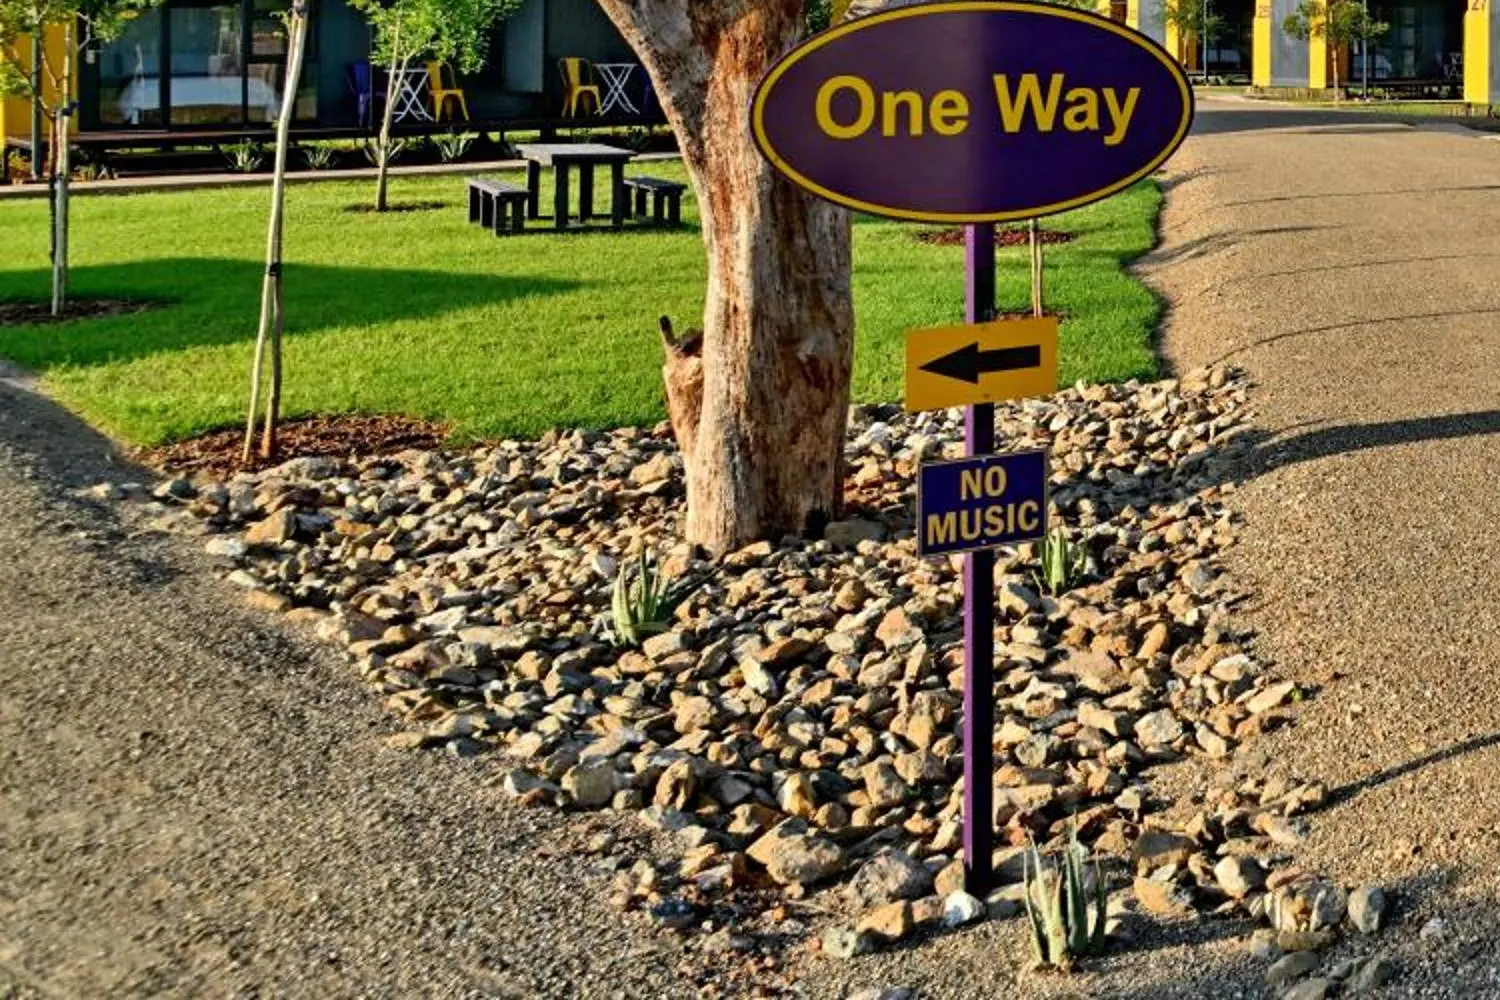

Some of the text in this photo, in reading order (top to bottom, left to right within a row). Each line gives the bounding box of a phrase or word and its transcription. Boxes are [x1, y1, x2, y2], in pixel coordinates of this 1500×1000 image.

[815, 73, 1140, 146] One Way
[960, 465, 1007, 500] NO
[927, 499, 1040, 546] MUSIC
